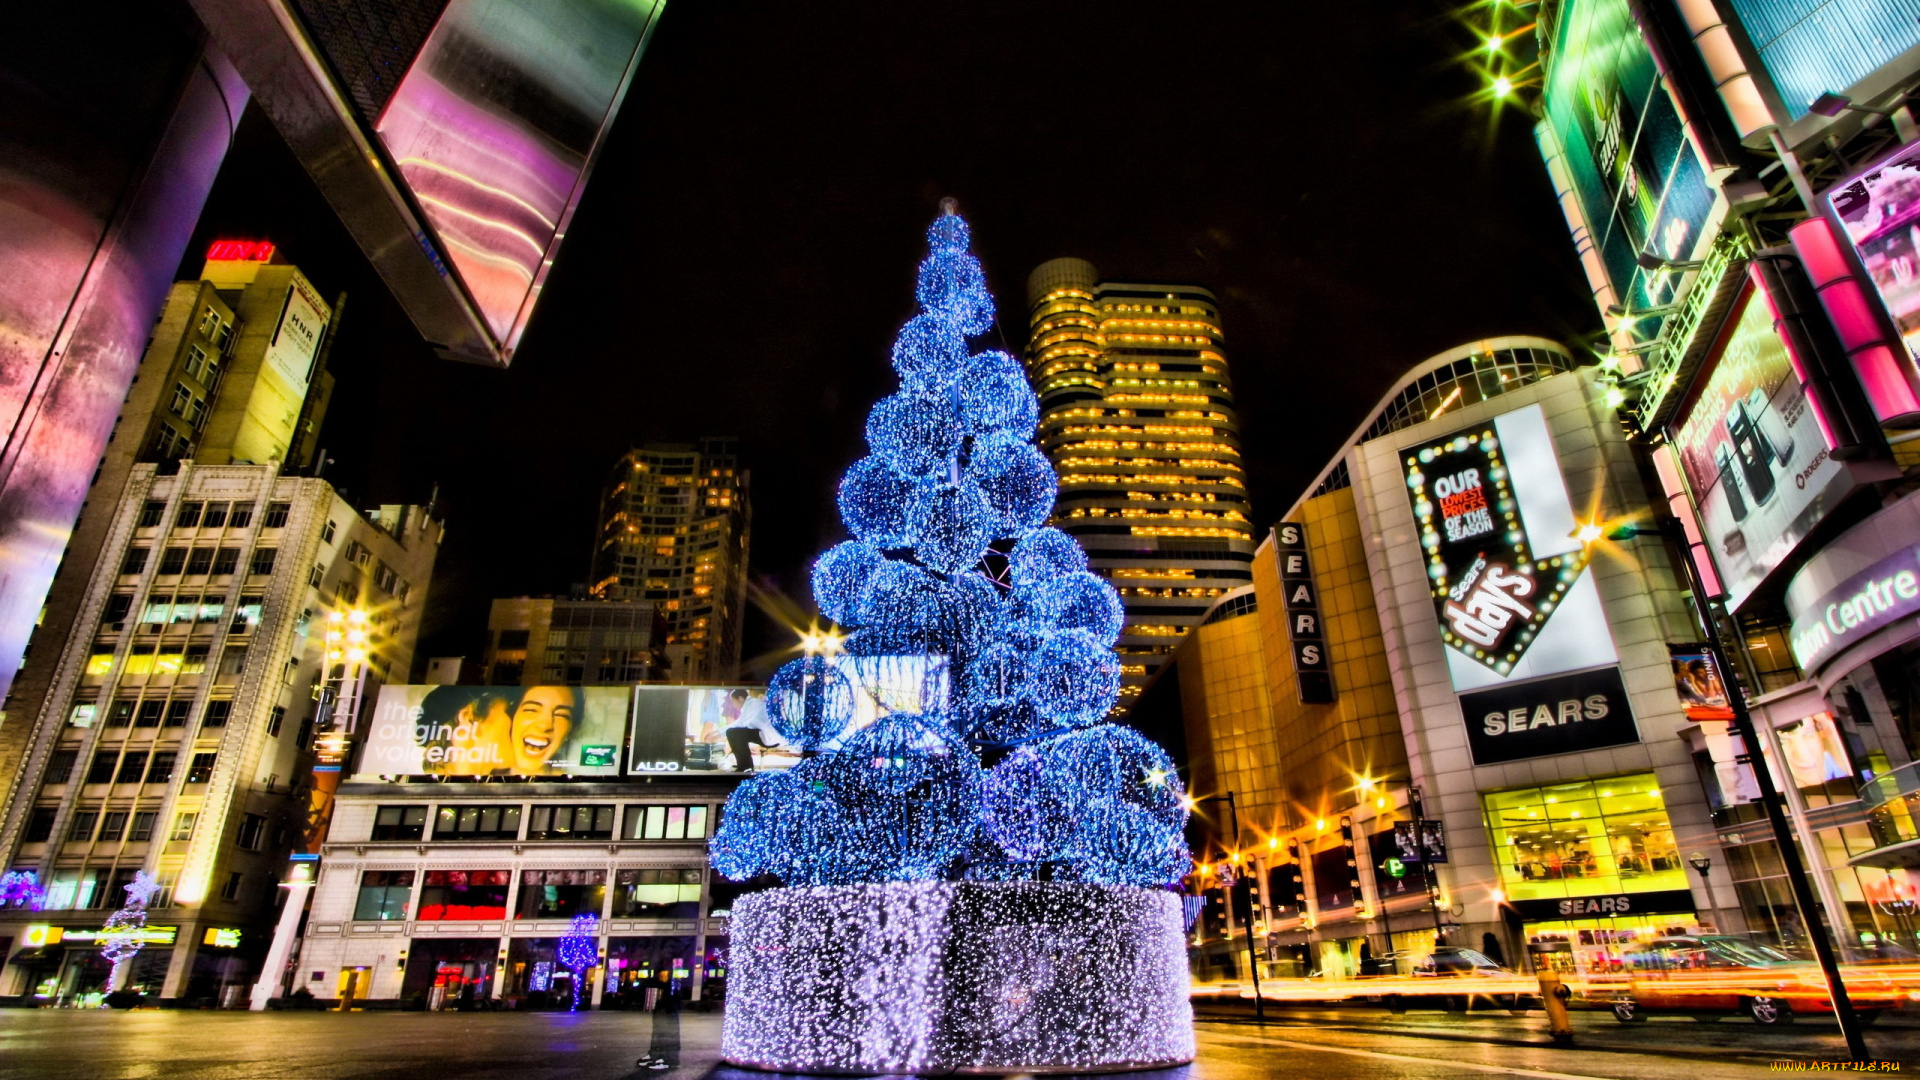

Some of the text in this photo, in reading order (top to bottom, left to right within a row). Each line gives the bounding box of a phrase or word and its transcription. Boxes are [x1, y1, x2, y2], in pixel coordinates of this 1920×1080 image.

[291, 313, 313, 342] HNR
[1804, 448, 1828, 479] ROGERS
[1434, 468, 1482, 499] OUR
[1439, 486, 1484, 510] LOWEST
[1442, 497, 1488, 520] PRICES
[1445, 507, 1490, 531] OF THE
[1447, 518, 1494, 542] SEASON
[1449, 557, 1487, 602] Sears
[1281, 526, 1320, 665] SEARS
[1447, 566, 1533, 647] days
[1825, 569, 1919, 634] Centre
[1700, 647, 1716, 681] DINING
[383, 700, 424, 720] the
[1483, 694, 1609, 736] SEARS
[379, 720, 479, 746] original
[374, 742, 503, 764] voicemail.
[636, 761, 679, 772] ALDO
[1389, 859, 1403, 874] P
[1559, 896, 1630, 915] SEARS
